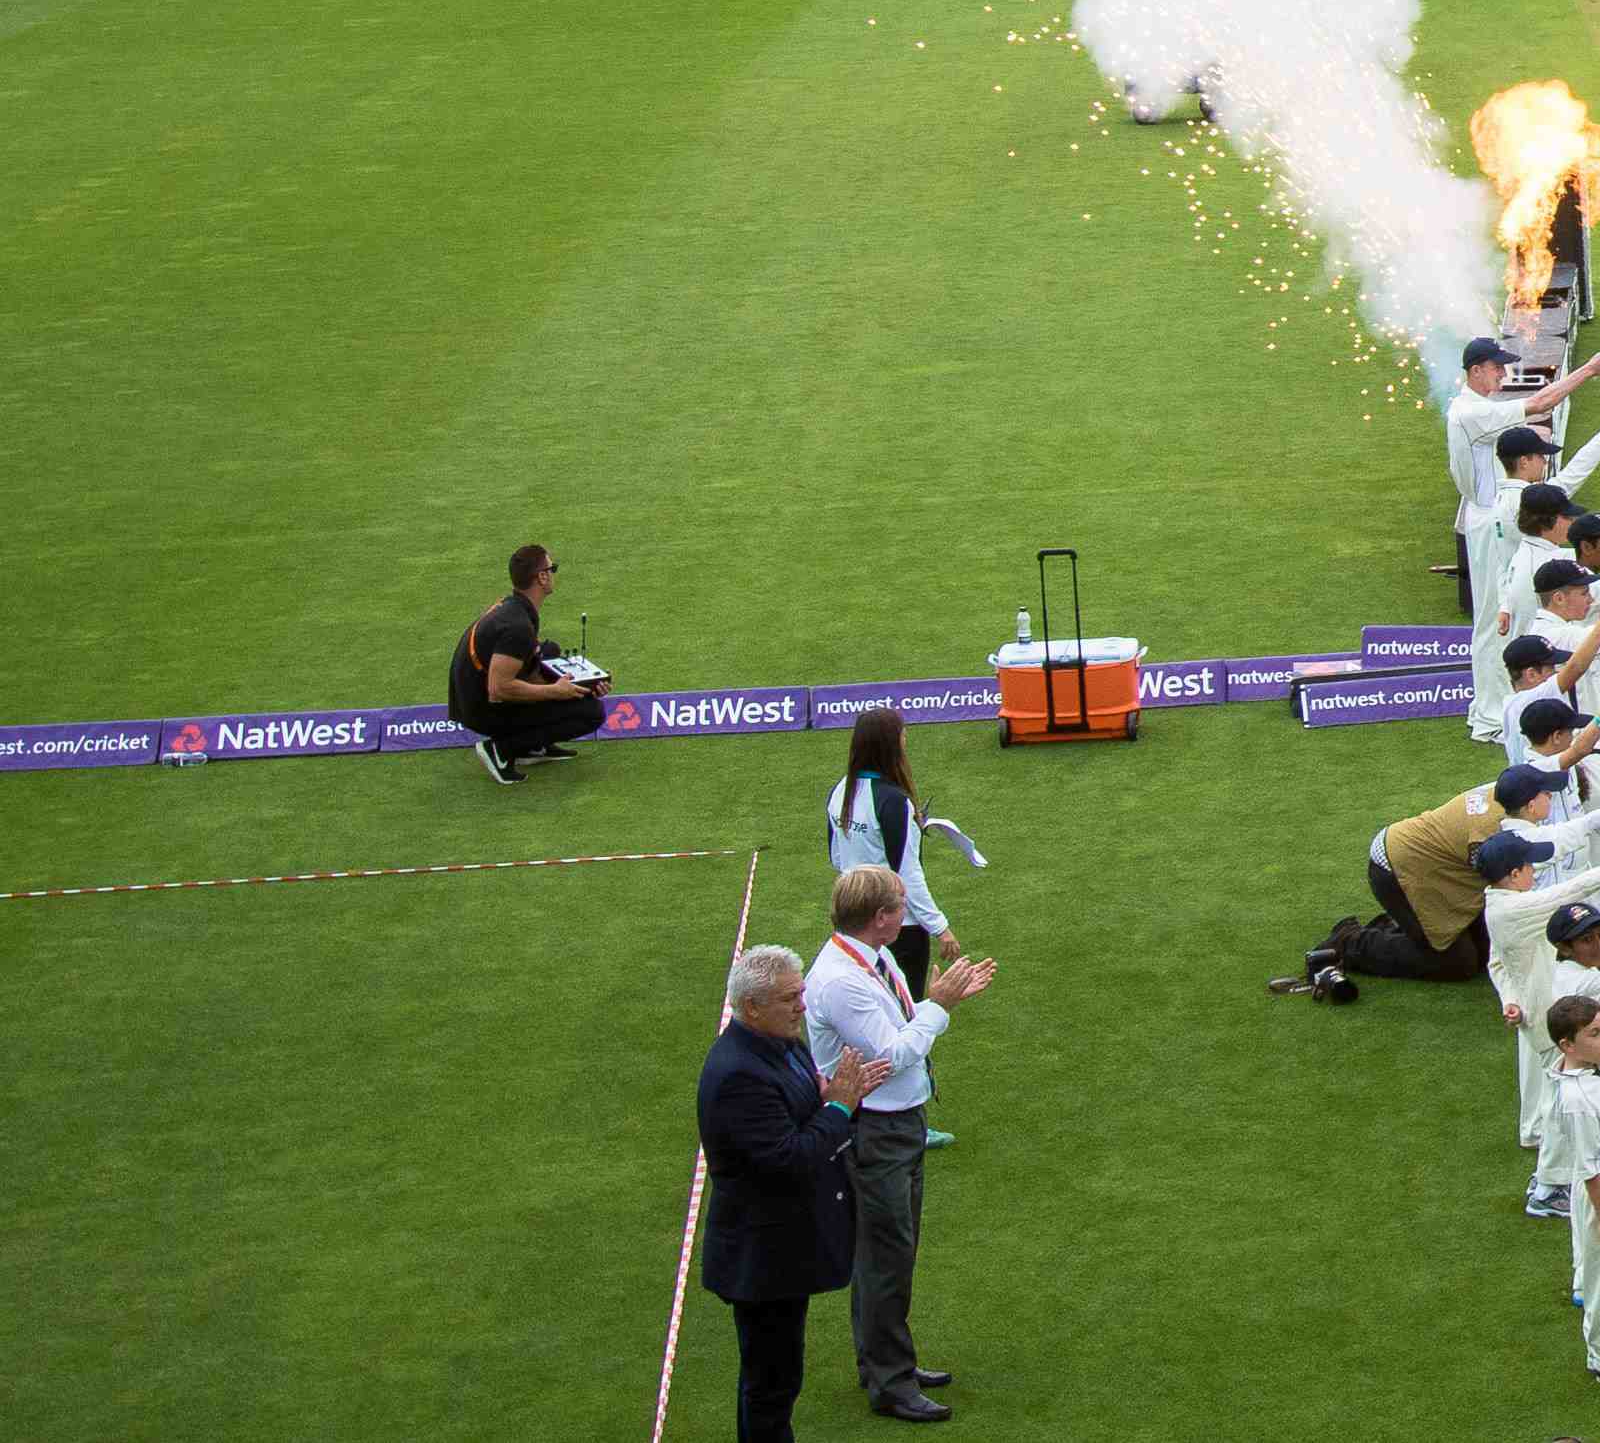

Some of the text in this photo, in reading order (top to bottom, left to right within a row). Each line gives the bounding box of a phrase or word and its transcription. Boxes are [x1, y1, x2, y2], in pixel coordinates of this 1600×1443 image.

[1138, 666, 1214, 699] West
[1228, 669, 1294, 686] natwes
[817, 687, 1003, 714] natwest.com/cricke
[1311, 683, 1474, 711] natwest.com/cric
[650, 695, 796, 728] NatWest
[0, 733, 150, 757] est.com/cricket
[217, 715, 367, 751] NatWest
